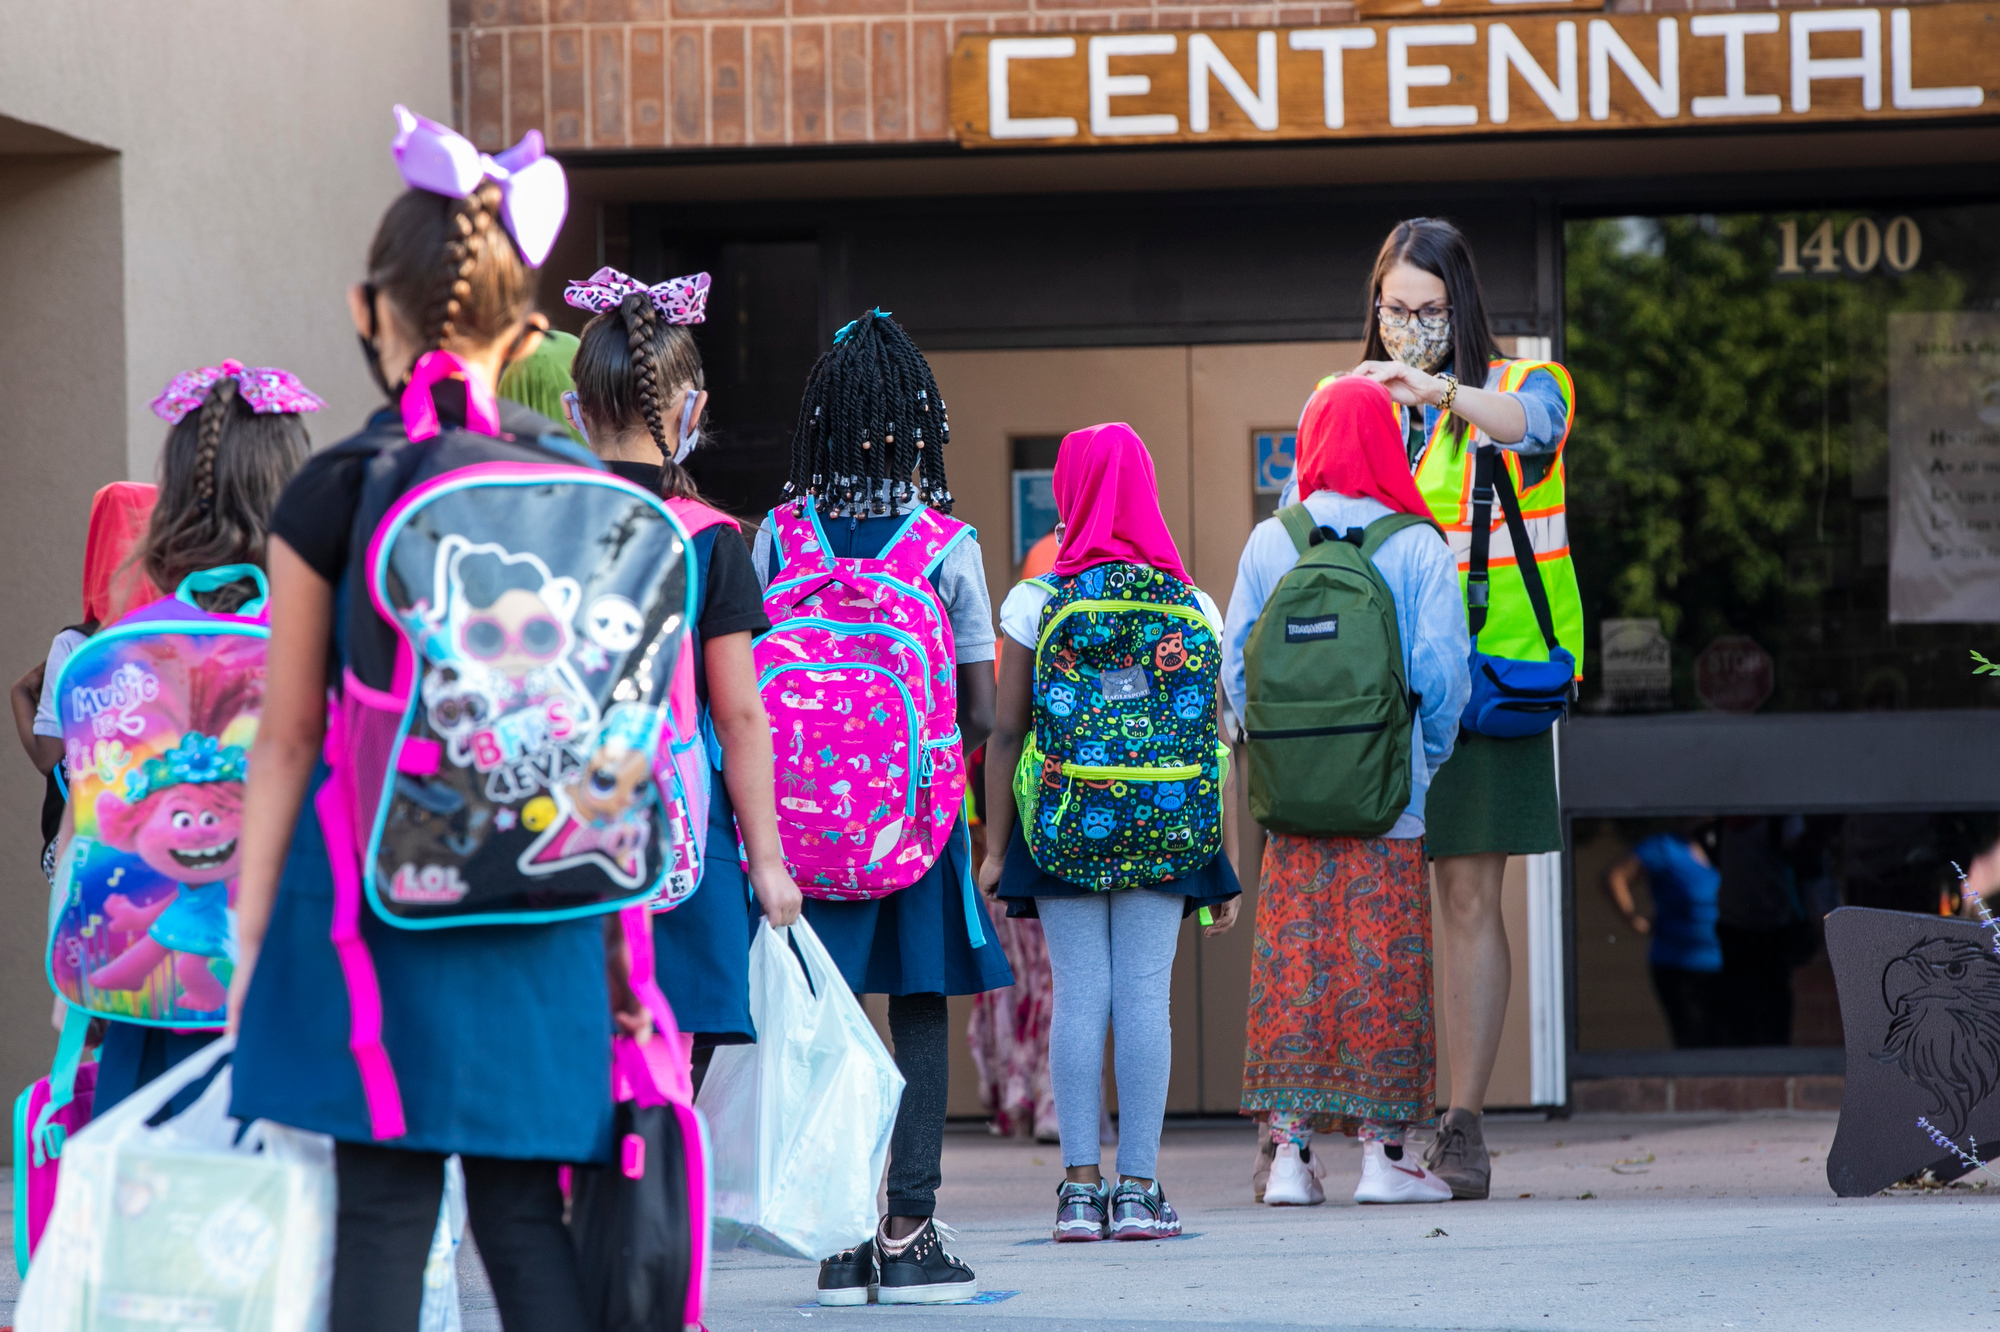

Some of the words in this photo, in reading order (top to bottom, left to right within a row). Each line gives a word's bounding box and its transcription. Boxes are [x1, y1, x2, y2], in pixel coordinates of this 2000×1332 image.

[988, 8, 1984, 138] CENTENNIAL
[1777, 216, 1922, 274] 1400
[1104, 688, 1148, 700] EAGLESPORT
